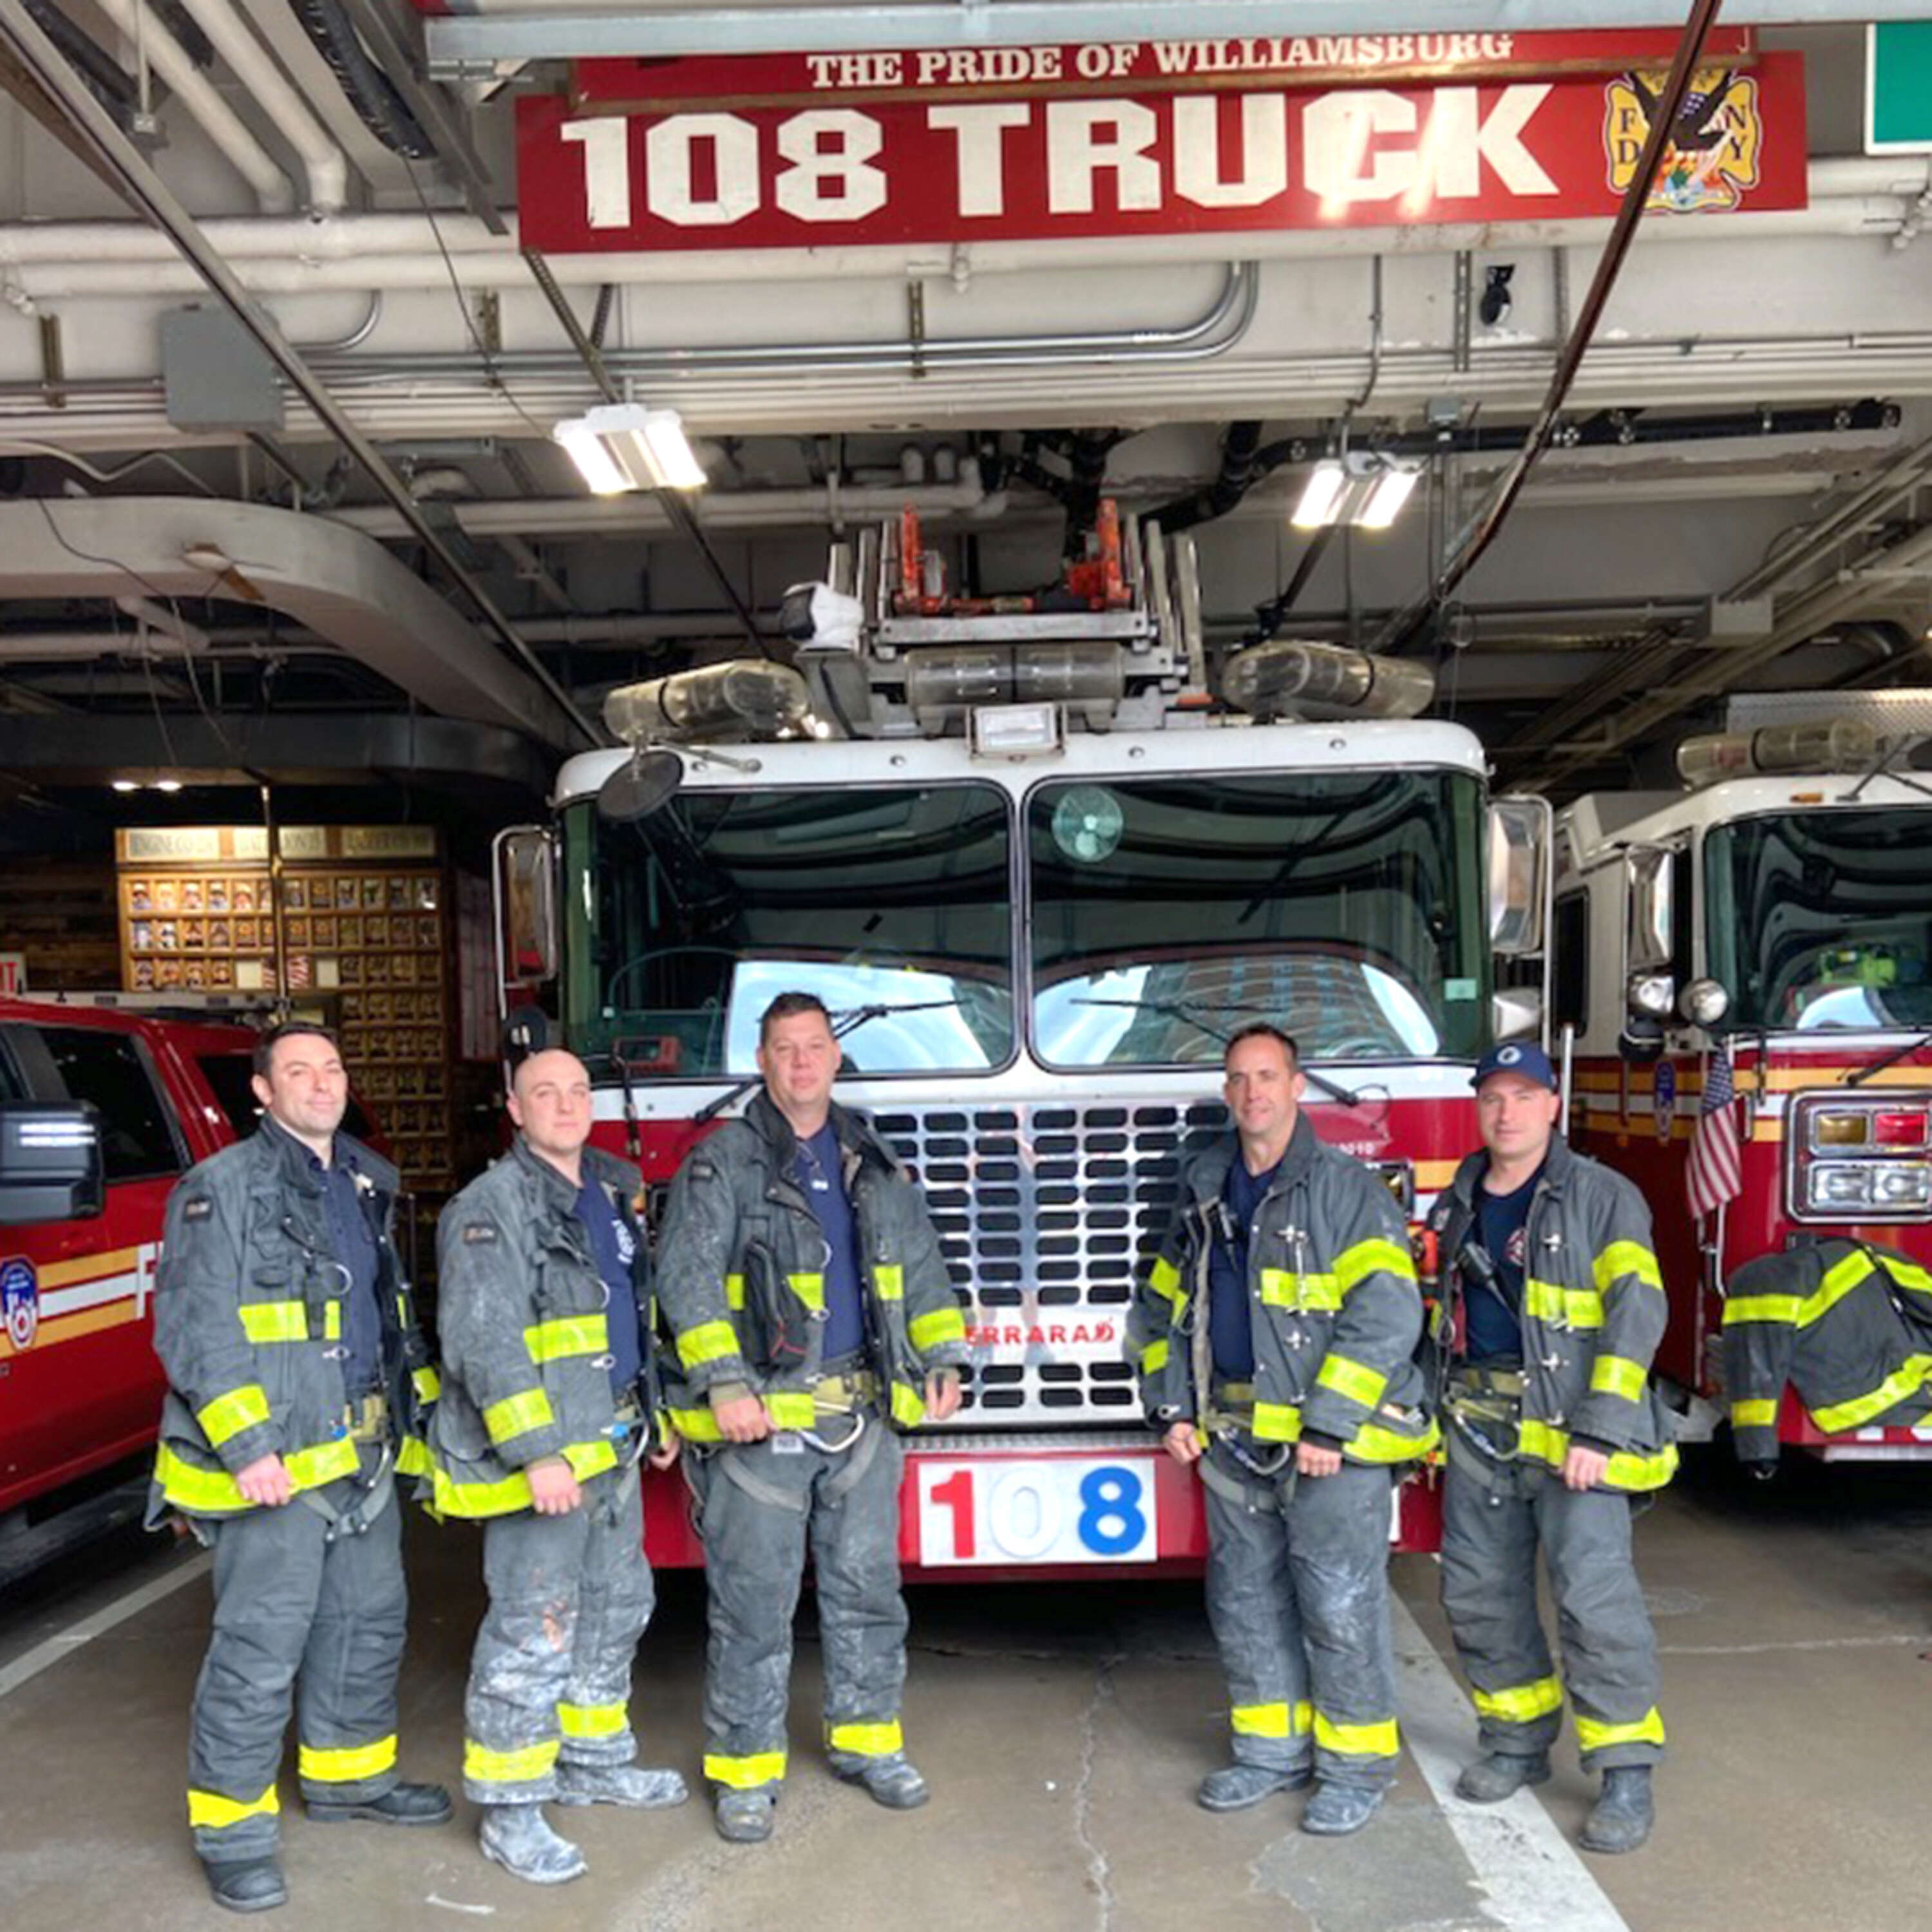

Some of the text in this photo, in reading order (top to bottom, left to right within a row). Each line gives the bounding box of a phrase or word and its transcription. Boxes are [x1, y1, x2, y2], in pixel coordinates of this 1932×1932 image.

[806, 32, 1515, 88] THE PRIDE OF WILLIAMSBURG
[560, 84, 1560, 229] 108 TRUCK
[929, 1465, 1147, 1560] 108
